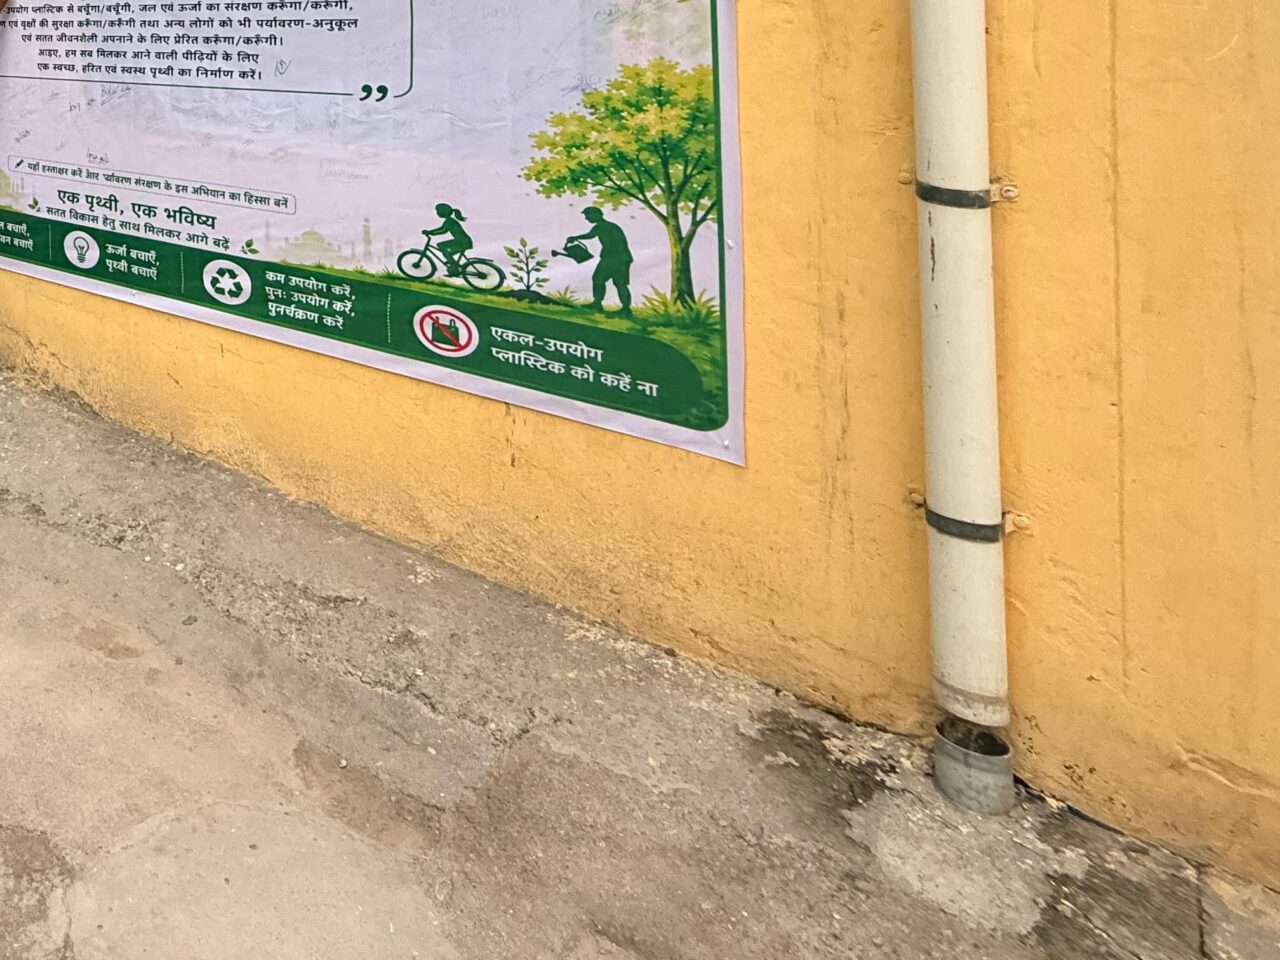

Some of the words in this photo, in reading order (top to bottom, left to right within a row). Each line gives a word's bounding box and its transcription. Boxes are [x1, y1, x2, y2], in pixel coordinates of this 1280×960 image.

[31, 3, 63, 14] प्लास्टिक
[67, 3, 74, 13] से
[138, 3, 157, 13] जल
[160, 2, 174, 13] एवं
[178, 0, 202, 12] ऊर्जा
[206, 2, 220, 12] का
[224, 0, 262, 12] संरक्षण
[8, 19, 18, 28] एवं
[21, 18, 36, 30] वृक्षों
[39, 18, 49, 28] की
[52, 20, 74, 31] सुरक्षा
[139, 19, 160, 28] तथा
[163, 19, 185, 29] अन्य
[189, 16, 215, 28] लोगों
[218, 16, 233, 28] को
[237, 16, 252, 28] भी
[256, 16, 359, 32] पर्यावरण-अनुकूल
[21, 33, 32, 43] एवं
[35, 34, 53, 43] सतत
[56, 32, 98, 44] जीवनशैली
[102, 33, 134, 44] अपनाने
[137, 32, 147, 44] के
[150, 33, 170, 46] लिए
[174, 33, 199, 45] प्रेरित
[38, 48, 62, 58] आइए,
[64, 49, 77, 58] हम
[80, 50, 94, 58] सब
[96, 47, 128, 59] मिलकर
[131, 48, 151, 60] आने
[154, 49, 178, 61] वाली
[182, 49, 218, 63] पीढ़ियों
[222, 49, 233, 61] के
[237, 50, 260, 64] लिए
[37, 62, 50, 71] एक
[52, 63, 79, 74] स्वच्छ,
[81, 62, 102, 74] हरित
[105, 64, 117, 75] एवं
[120, 66, 146, 76] स्वस्थ
[150, 65, 174, 79] पृथ्वी
[178, 67, 192, 78] का
[196, 66, 234, 79] निर्माण
[238, 68, 262, 81] करें।
[41, 164, 69, 176] हस्ताक्षर
[70, 167, 83, 178] करें
[134, 176, 162, 190] संरक्षण
[164, 180, 173, 191] के
[174, 183, 189, 194] इस
[191, 185, 226, 200] अभियान
[228, 192, 241, 202] का
[244, 191, 271, 206] हिस्सा
[273, 196, 289, 209] बनें
[57, 189, 80, 206] एक
[85, 193, 125, 216] पृथ्वी,
[131, 202, 158, 219] एक
[164, 205, 217, 230] भविष्य
[46, 206, 67, 220] सतत
[69, 208, 99, 225] विकास
[102, 215, 116, 231] हेतु
[119, 220, 141, 233] साथ
[144, 221, 181, 241] मिलकर
[186, 232, 209, 246] आगे
[105, 243, 128, 257] ऊर्जा
[105, 258, 128, 272] पृथ्वी
[265, 270, 286, 284] कम
[288, 275, 328, 292] उपयोग
[330, 283, 356, 300] करें,
[268, 302, 319, 324] पुनर्चक्रण
[322, 315, 344, 330] करें
[290, 292, 329, 309] उपयोग
[332, 300, 355, 317] करें,
[490, 326, 604, 362] एकल-उपयोग
[490, 346, 566, 374] प्लास्टिक
[570, 364, 595, 382] को
[600, 371, 632, 391] कहें
[637, 381, 659, 396] ना
